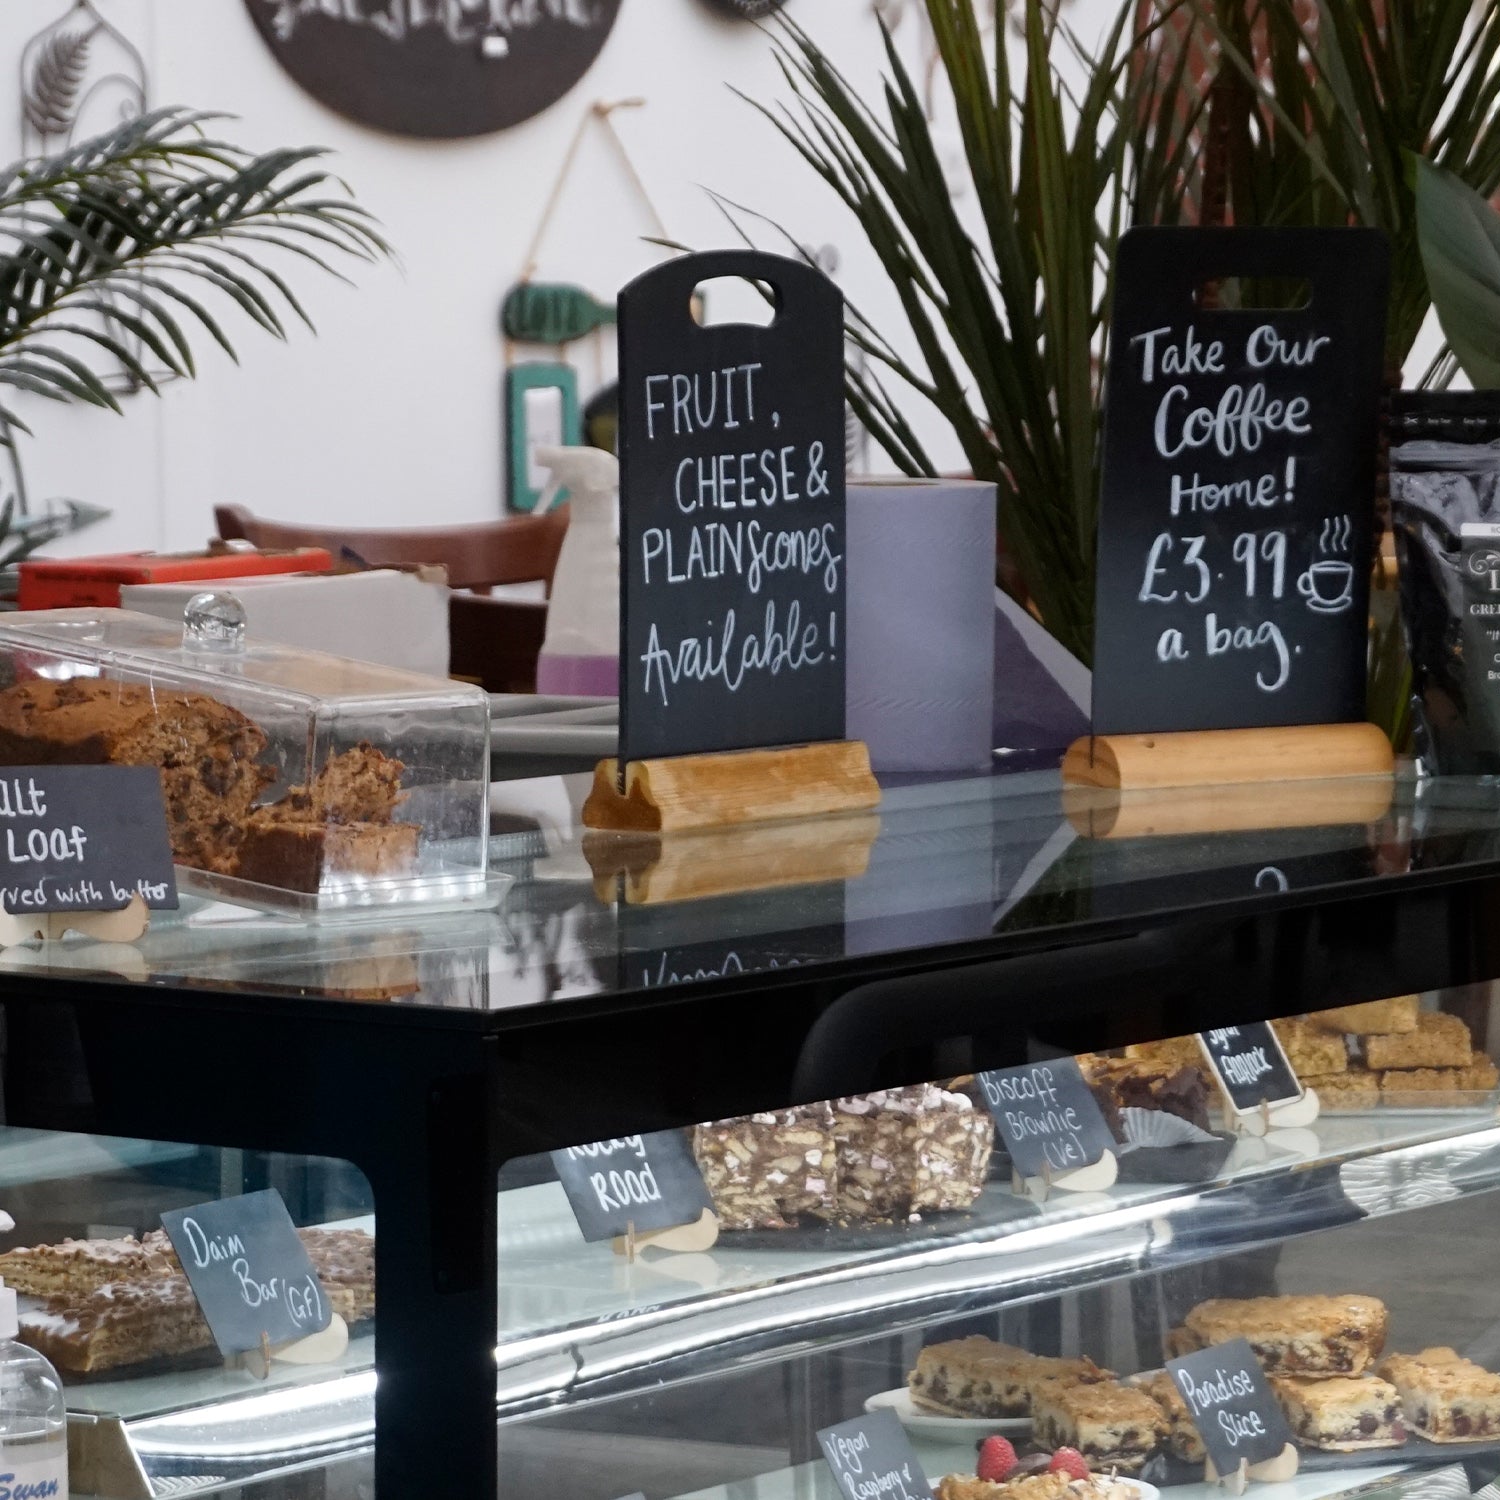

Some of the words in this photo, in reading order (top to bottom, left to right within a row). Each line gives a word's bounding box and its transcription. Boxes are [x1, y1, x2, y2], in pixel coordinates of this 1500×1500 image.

[1129, 325, 1225, 383] Take
[1246, 324, 1331, 367] Our
[1154, 382, 1312, 457] Coffee
[675, 446, 799, 513] CHEESE
[806, 440, 830, 498] &
[1170, 456, 1297, 516] Home!
[642, 521, 742, 584] PLAIN
[748, 519, 842, 594] Scones
[1139, 531, 1287, 602] £3.99
[640, 600, 837, 706] Available!
[1157, 627, 1190, 662] a
[1206, 612, 1302, 691] bag.
[56, 880, 103, 904] with
[980, 1067, 1057, 1107] Biscoff
[1005, 1104, 1082, 1141] Brownie
[590, 1162, 662, 1212] Road
[183, 1216, 246, 1268] Daim
[232, 1257, 278, 1307] Bar
[283, 1274, 323, 1328] (GF)
[1178, 1368, 1255, 1416] Paradise
[825, 1431, 870, 1474] Vegan
[1218, 1409, 1266, 1447] Slice
